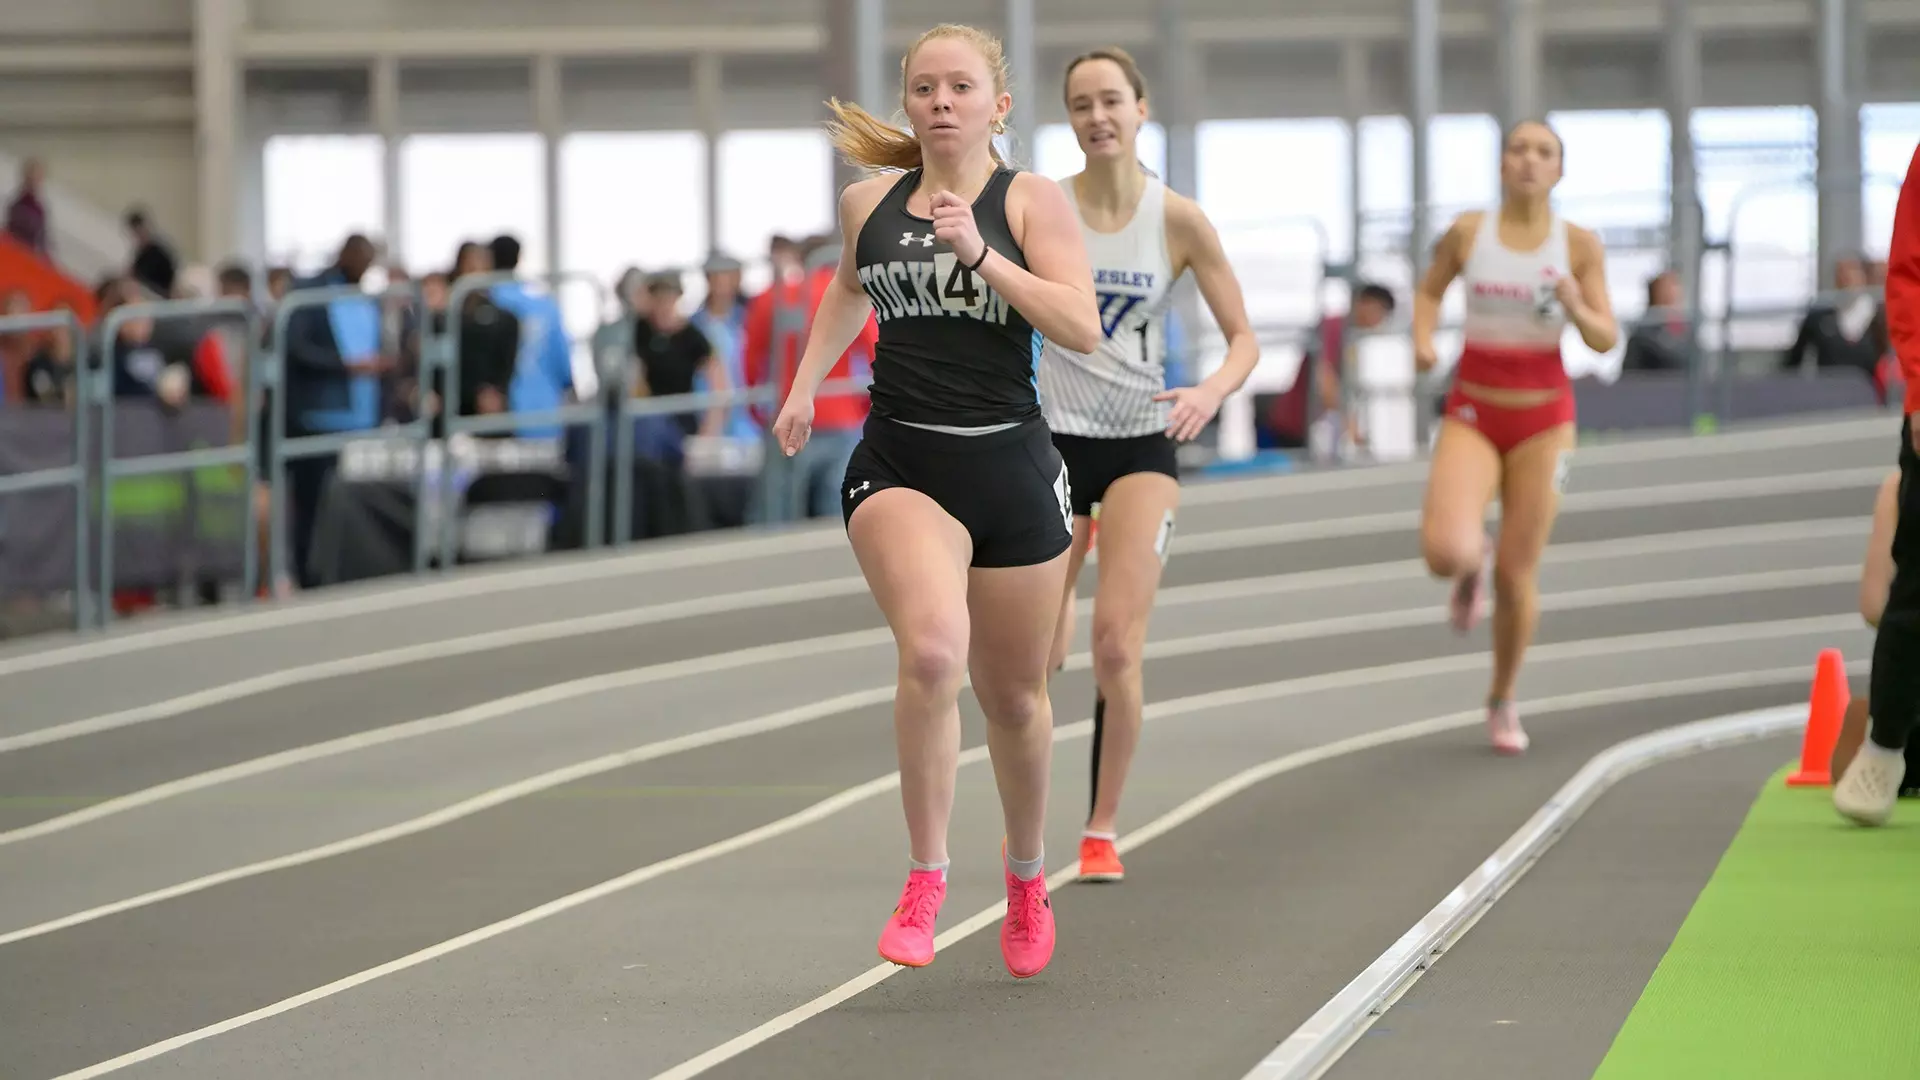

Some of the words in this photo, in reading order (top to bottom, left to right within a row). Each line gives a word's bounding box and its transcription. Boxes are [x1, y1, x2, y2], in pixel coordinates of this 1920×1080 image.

[857, 261, 1007, 325] TOCKN
[944, 258, 979, 306] 4
[1095, 269, 1155, 287] ESLEY
[1133, 320, 1148, 361] 1
